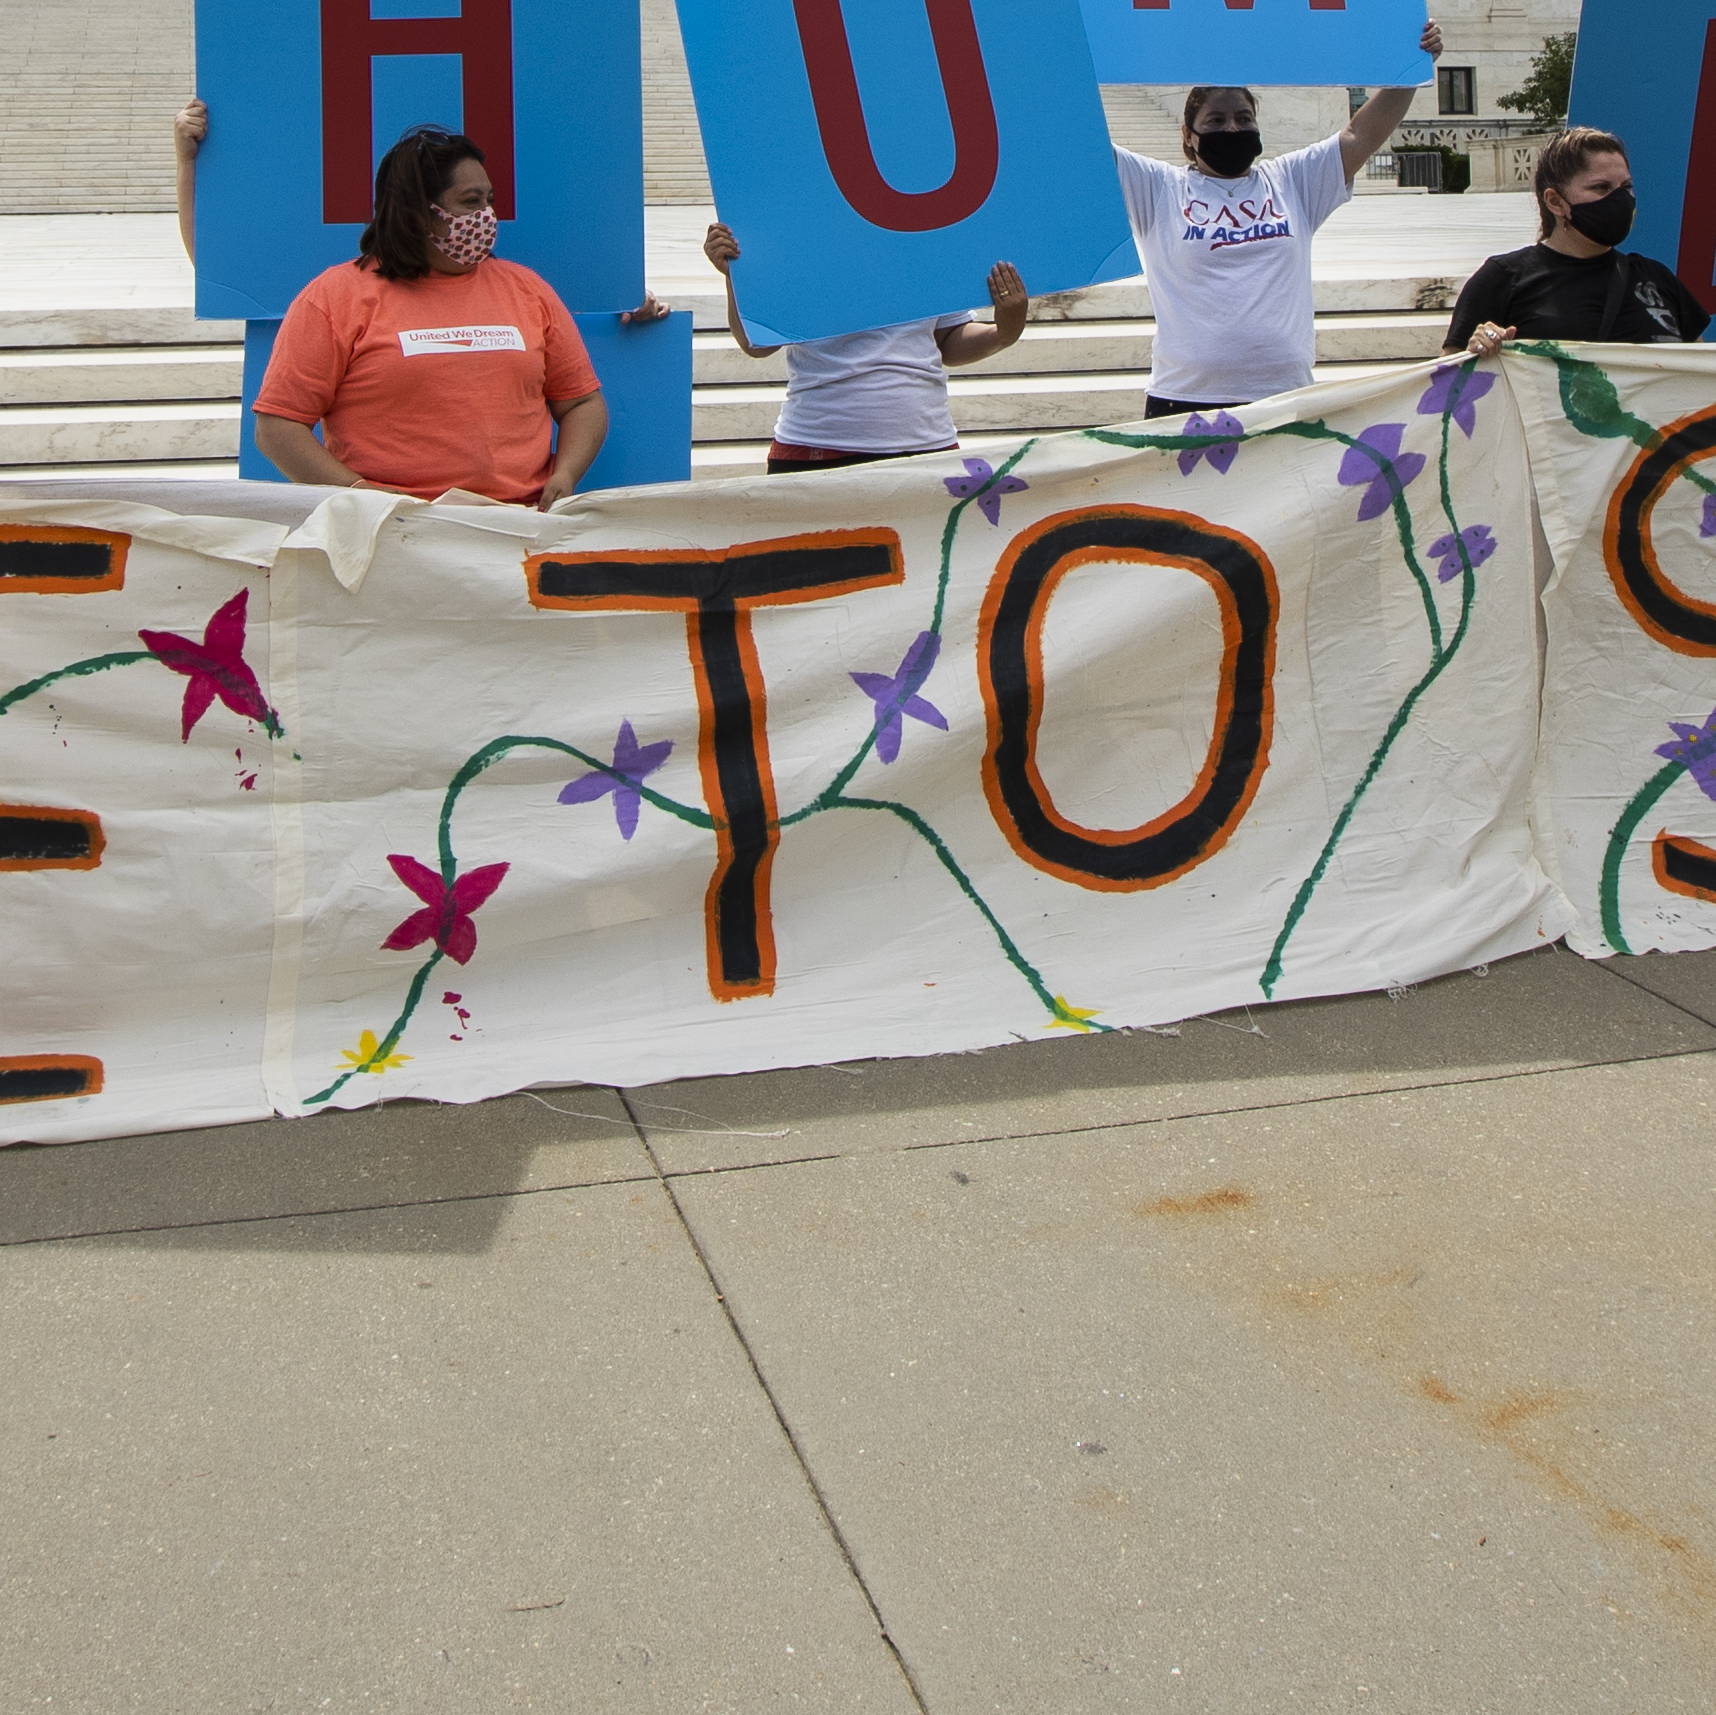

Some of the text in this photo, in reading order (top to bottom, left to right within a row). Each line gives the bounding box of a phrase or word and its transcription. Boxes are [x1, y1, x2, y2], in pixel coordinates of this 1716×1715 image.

[1184, 199, 1285, 228] CASA
[1183, 221, 1291, 243] IN ACTION
[409, 329, 514, 341] United We Dream
[472, 338, 515, 347] ACTION
[524, 502, 1281, 1003] TO
